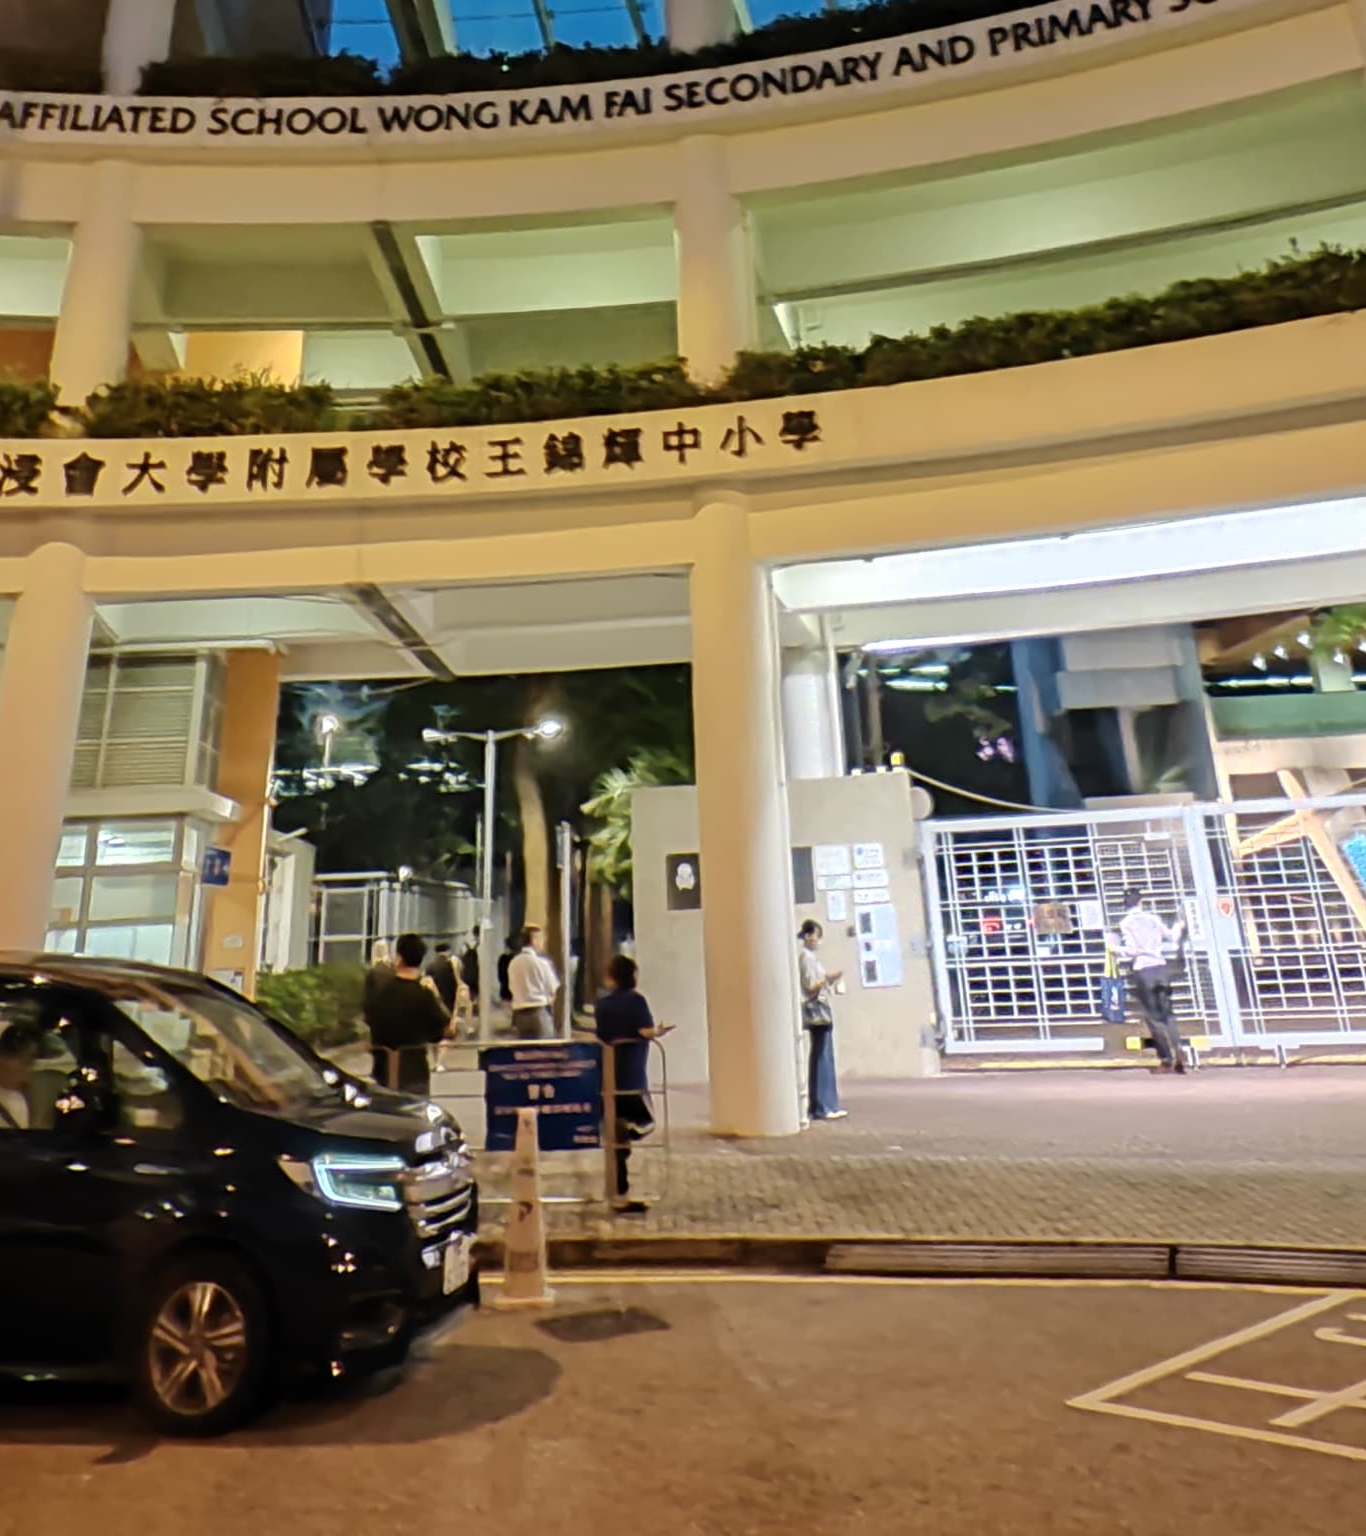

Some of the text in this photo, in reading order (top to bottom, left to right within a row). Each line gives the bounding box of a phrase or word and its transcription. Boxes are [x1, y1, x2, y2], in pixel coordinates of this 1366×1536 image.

[207, 104, 367, 137] SCHOOL
[377, 101, 501, 133] WONG
[509, 95, 592, 128] KAM
[605, 86, 652, 119] FAI
[664, 52, 882, 113] SECONDARY
[892, 35, 975, 77] AND
